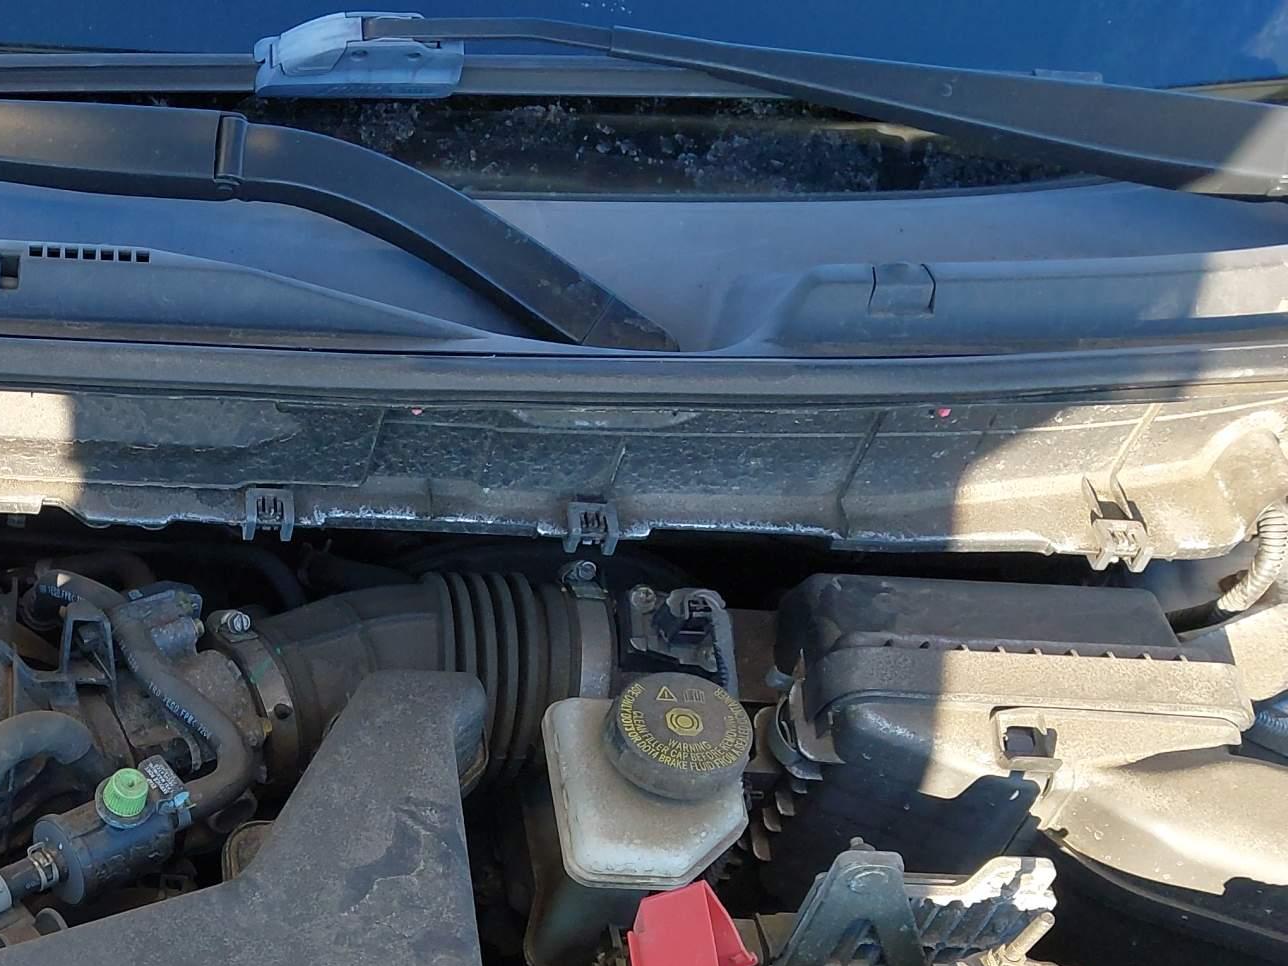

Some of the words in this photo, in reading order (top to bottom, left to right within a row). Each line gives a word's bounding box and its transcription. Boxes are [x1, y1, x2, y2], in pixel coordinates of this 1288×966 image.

[632, 709, 648, 734] CLEAN
[641, 732, 669, 755] FILLER
[670, 748, 689, 761] CAP
[690, 745, 724, 763] BEFORE
[668, 737, 712, 752] WARNING
[658, 754, 689, 771] BRAKE
[690, 760, 716, 772] FLUID
